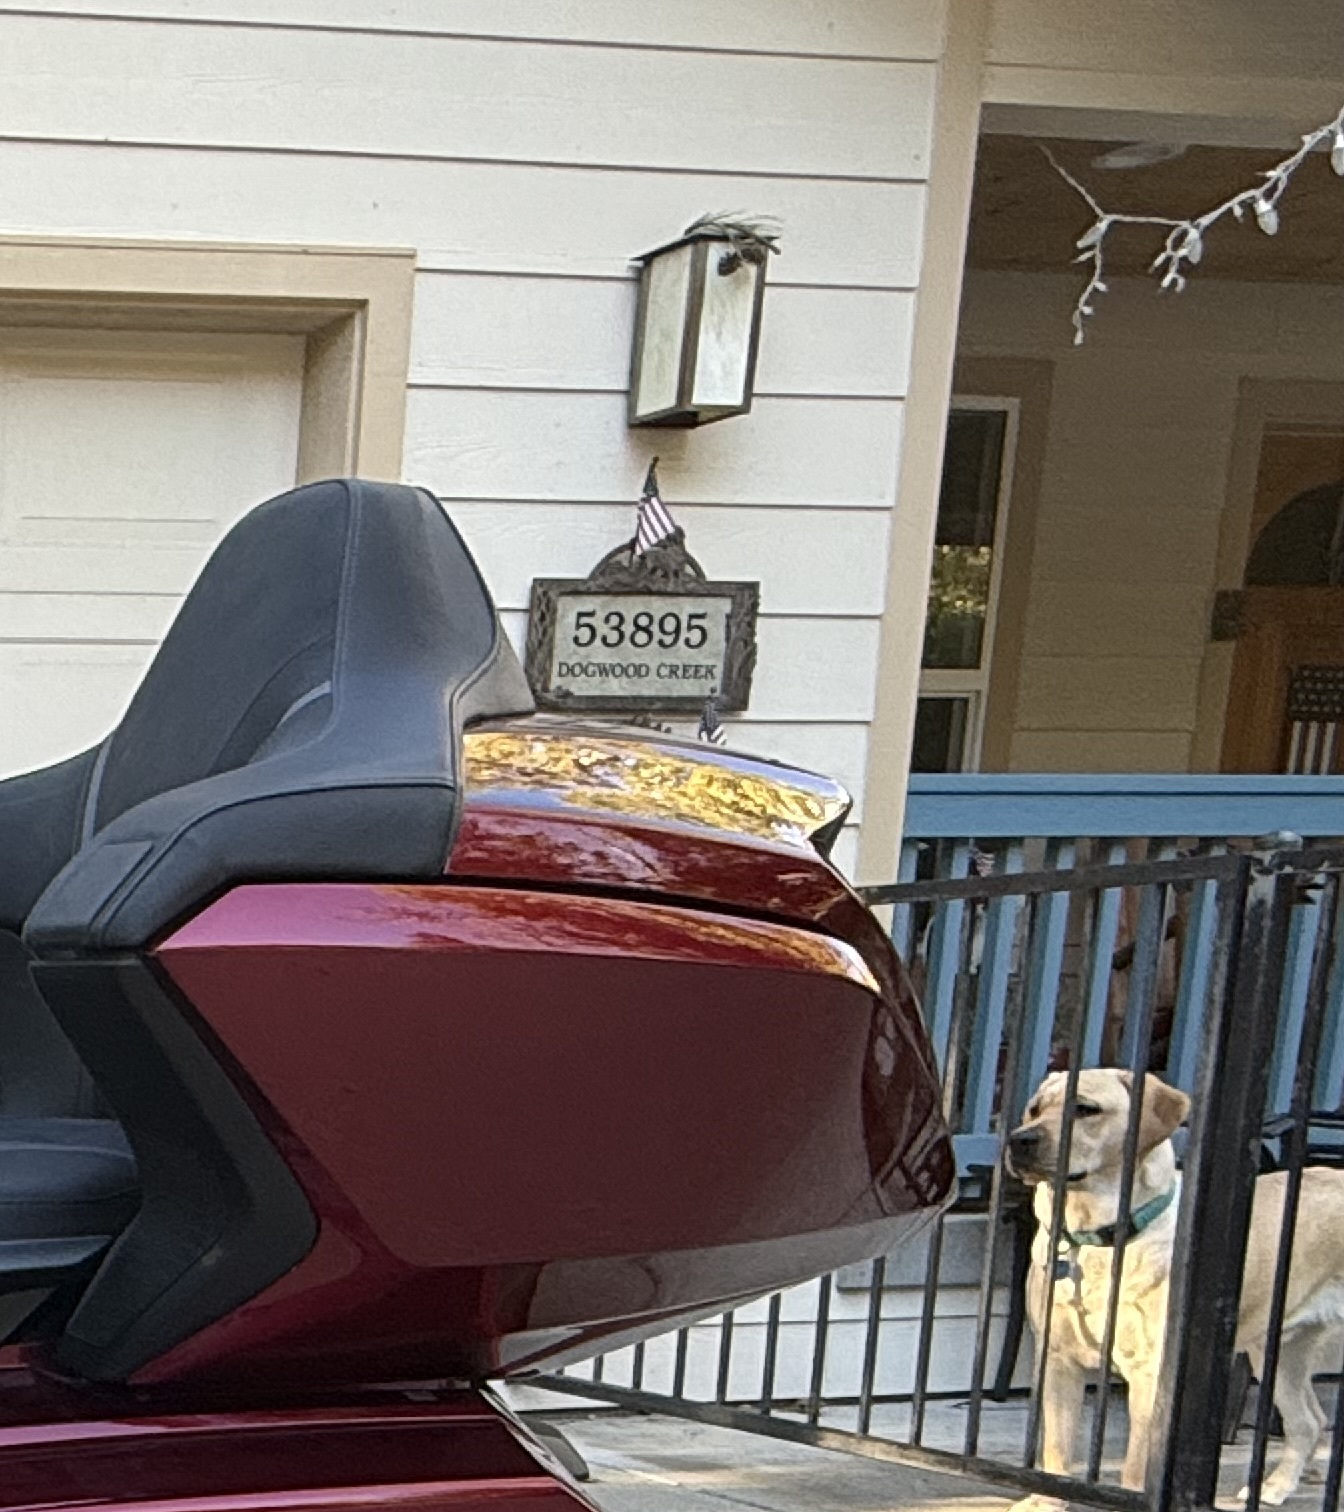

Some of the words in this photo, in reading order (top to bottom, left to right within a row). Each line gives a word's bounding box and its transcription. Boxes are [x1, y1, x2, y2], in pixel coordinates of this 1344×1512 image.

[573, 609, 708, 649] 53895
[558, 662, 650, 678] DOGWOOD
[656, 664, 717, 680] CREEK
